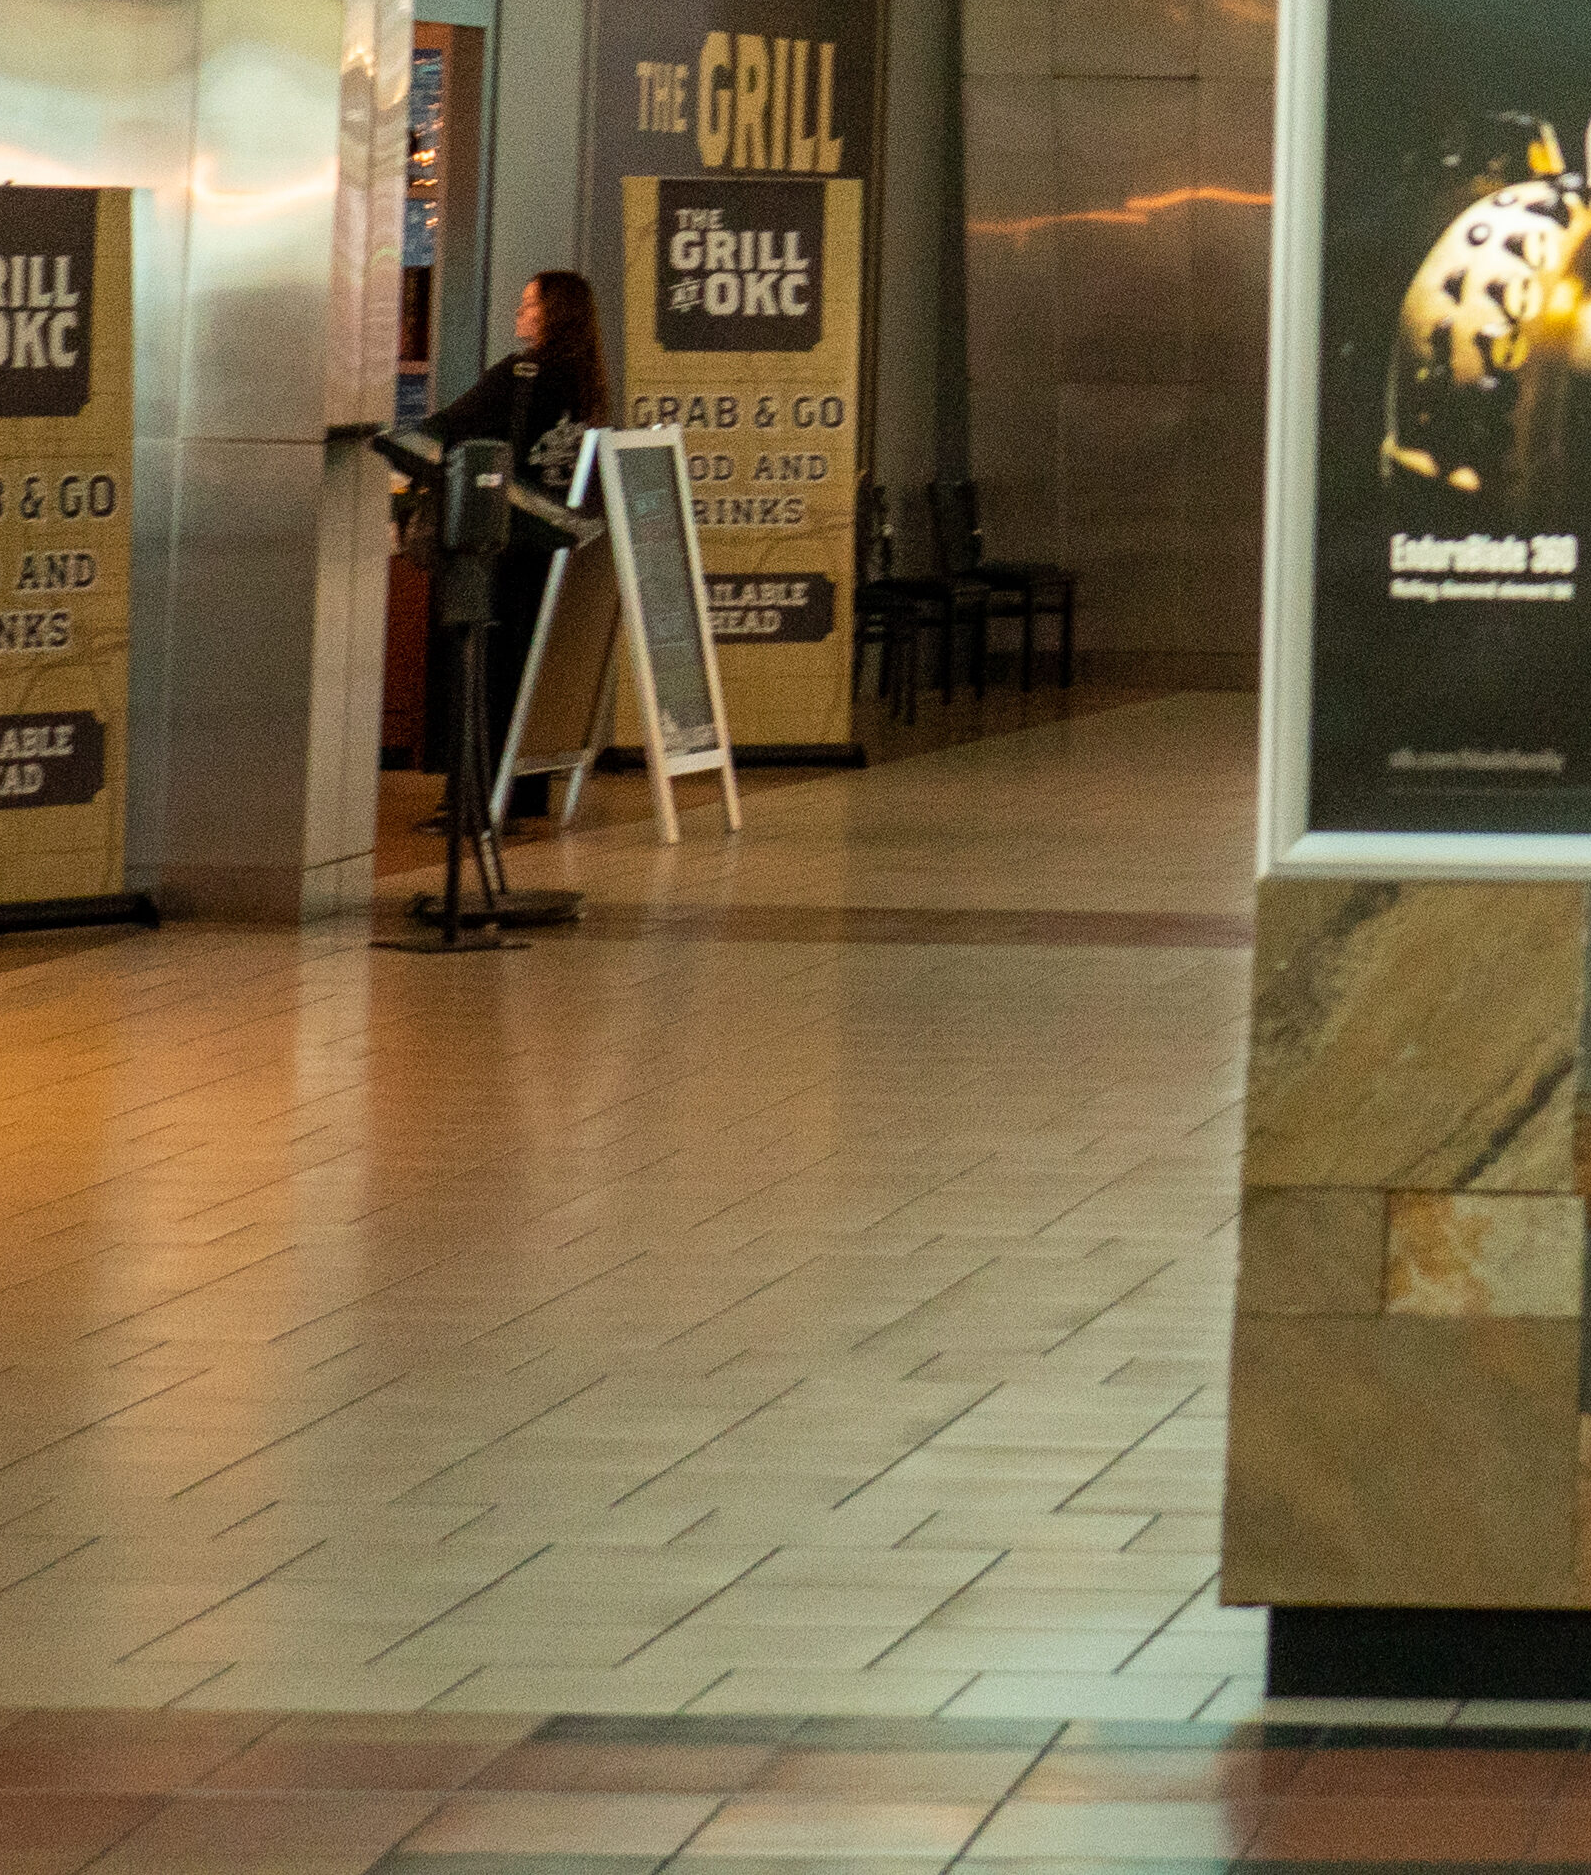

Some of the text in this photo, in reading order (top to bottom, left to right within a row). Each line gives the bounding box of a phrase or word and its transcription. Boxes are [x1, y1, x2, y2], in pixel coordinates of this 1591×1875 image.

[636, 30, 844, 173] THE GRILL
[675, 207, 725, 230] THE
[669, 230, 810, 272] GRILL
[705, 273, 810, 317] OKC
[632, 395, 845, 429] GRAB & GO
[689, 453, 828, 481] OD AND
[20, 475, 44, 520] &
[59, 475, 116, 519] GO
[691, 497, 806, 525] RINKS
[17, 552, 98, 592] AND
[707, 609, 782, 635] HEAD
